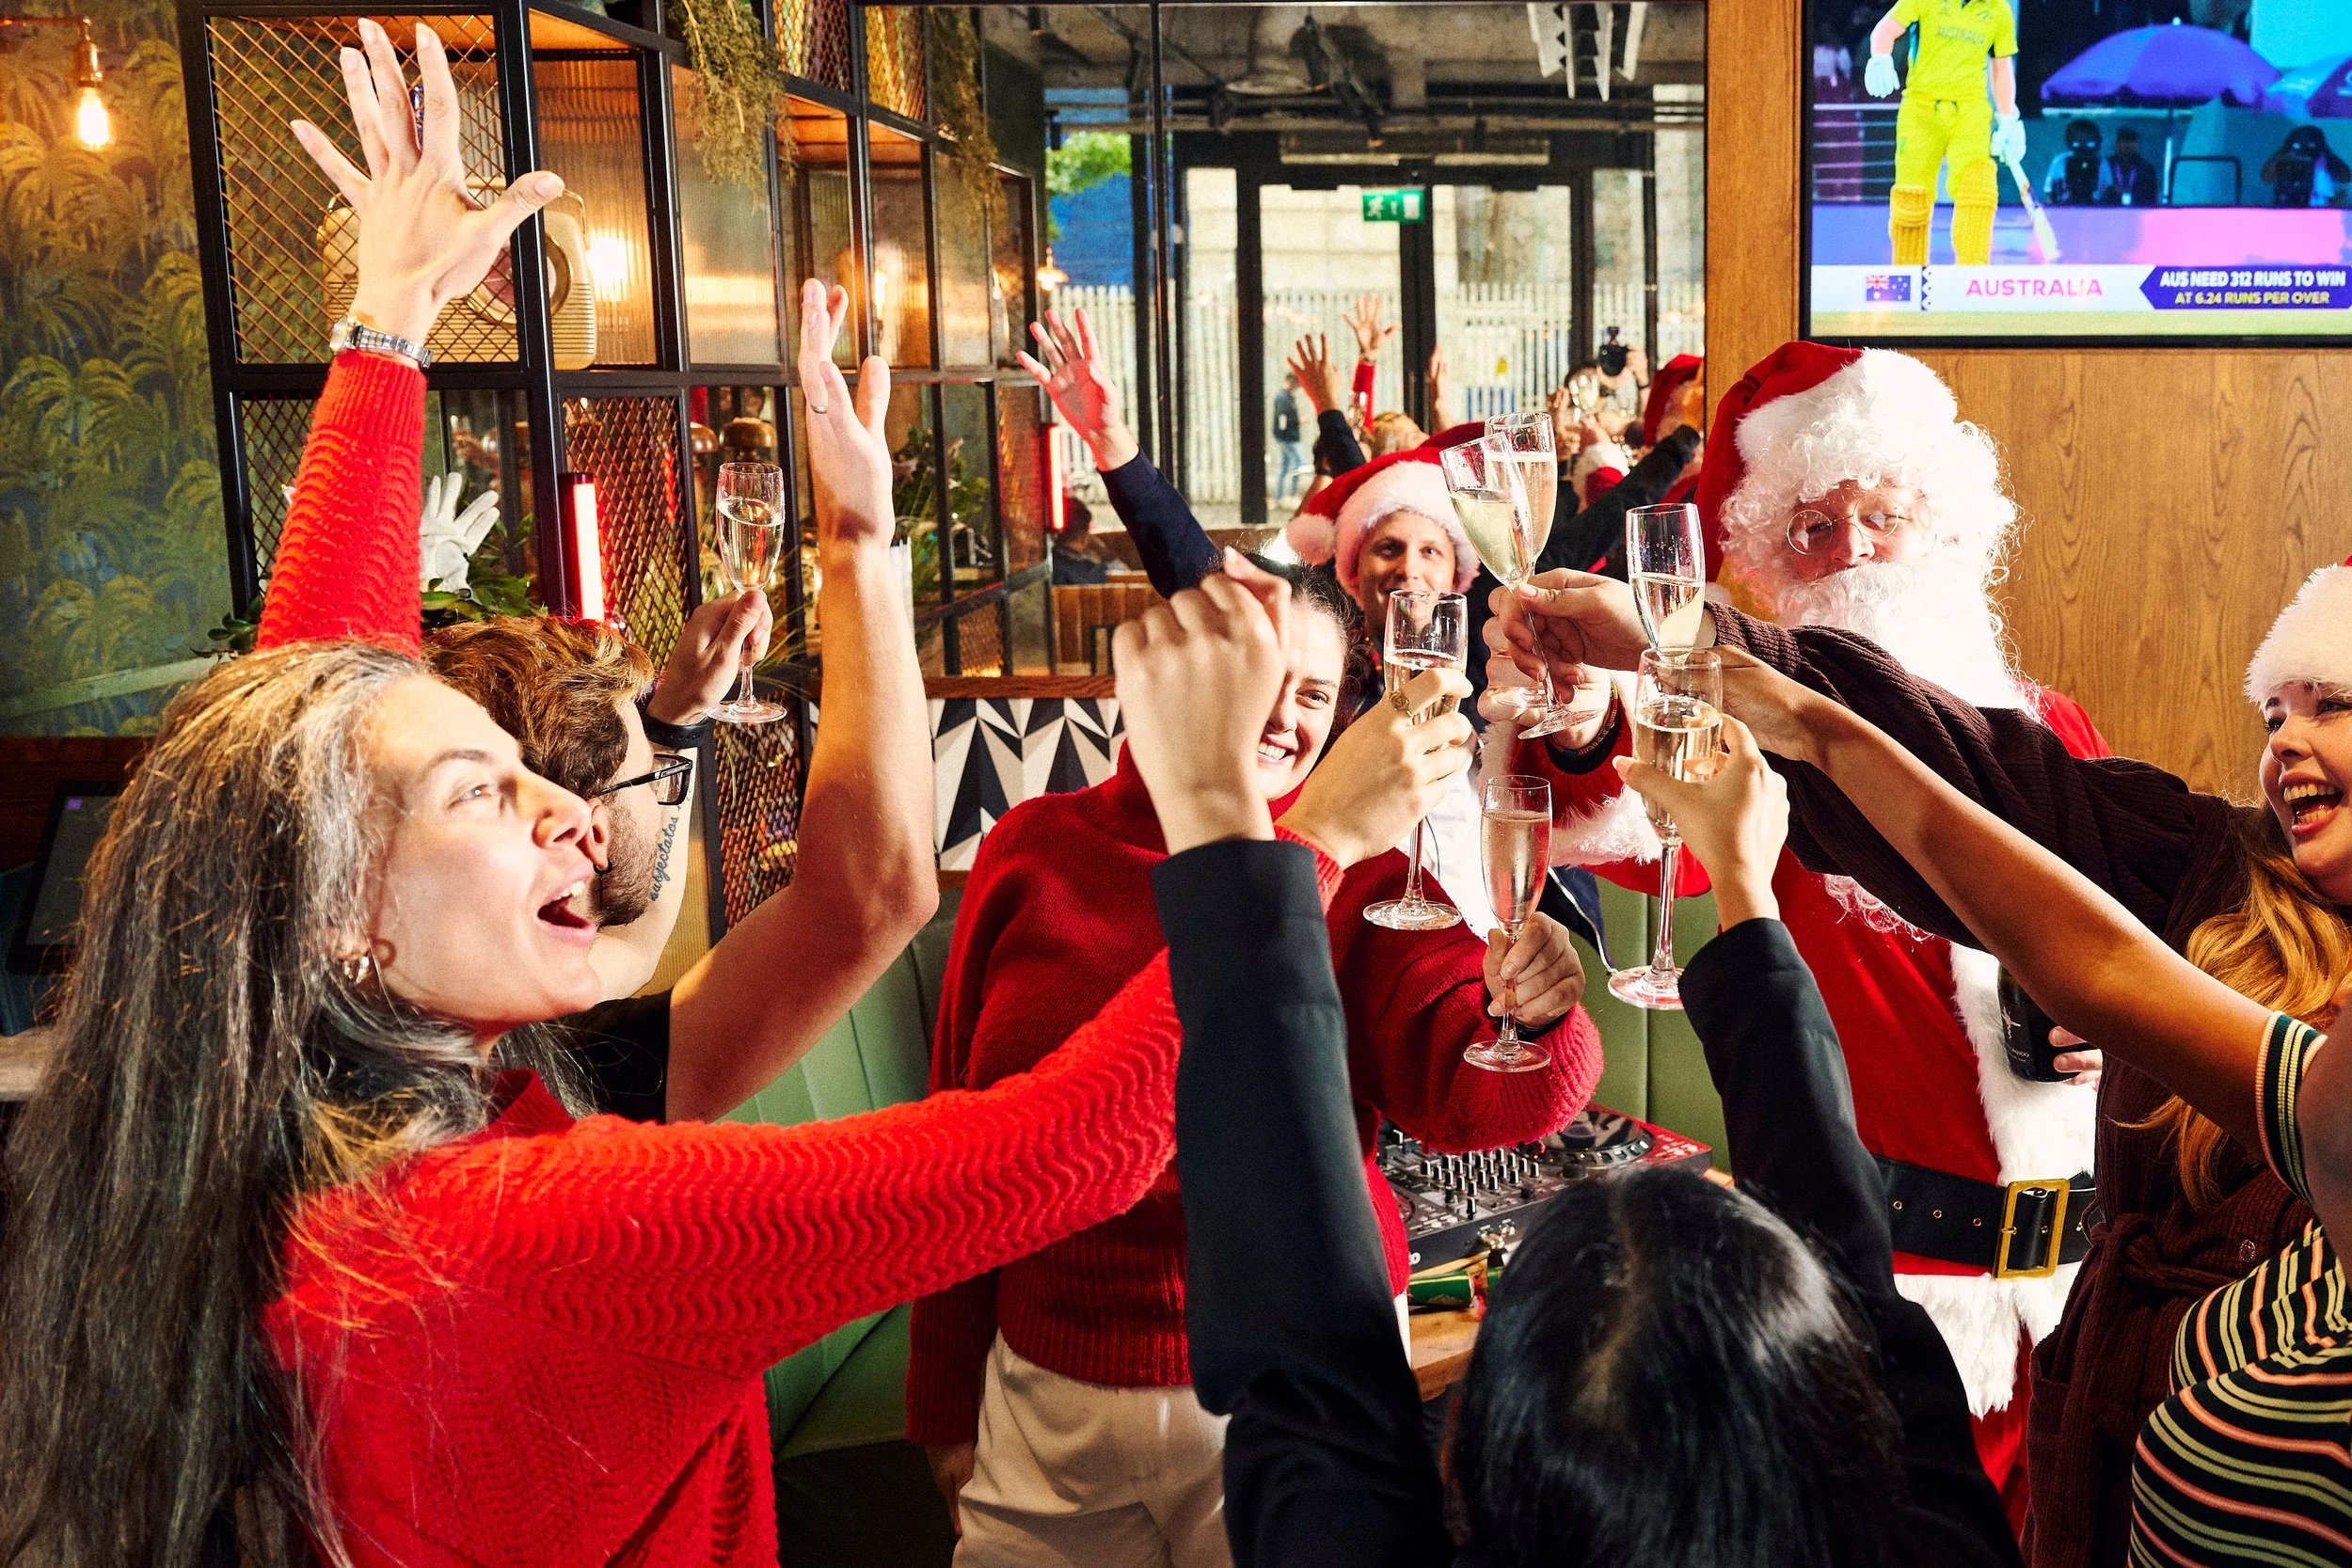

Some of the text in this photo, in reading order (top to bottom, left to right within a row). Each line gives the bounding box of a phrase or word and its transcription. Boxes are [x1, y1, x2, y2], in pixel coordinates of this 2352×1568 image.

[1965, 279, 2104, 297] AUSTRALIA
[2159, 270, 2346, 288] AUS NEED 312 RUNS TO WIN
[2174, 291, 2330, 305] AT 6.24 RUNS PER OVER
